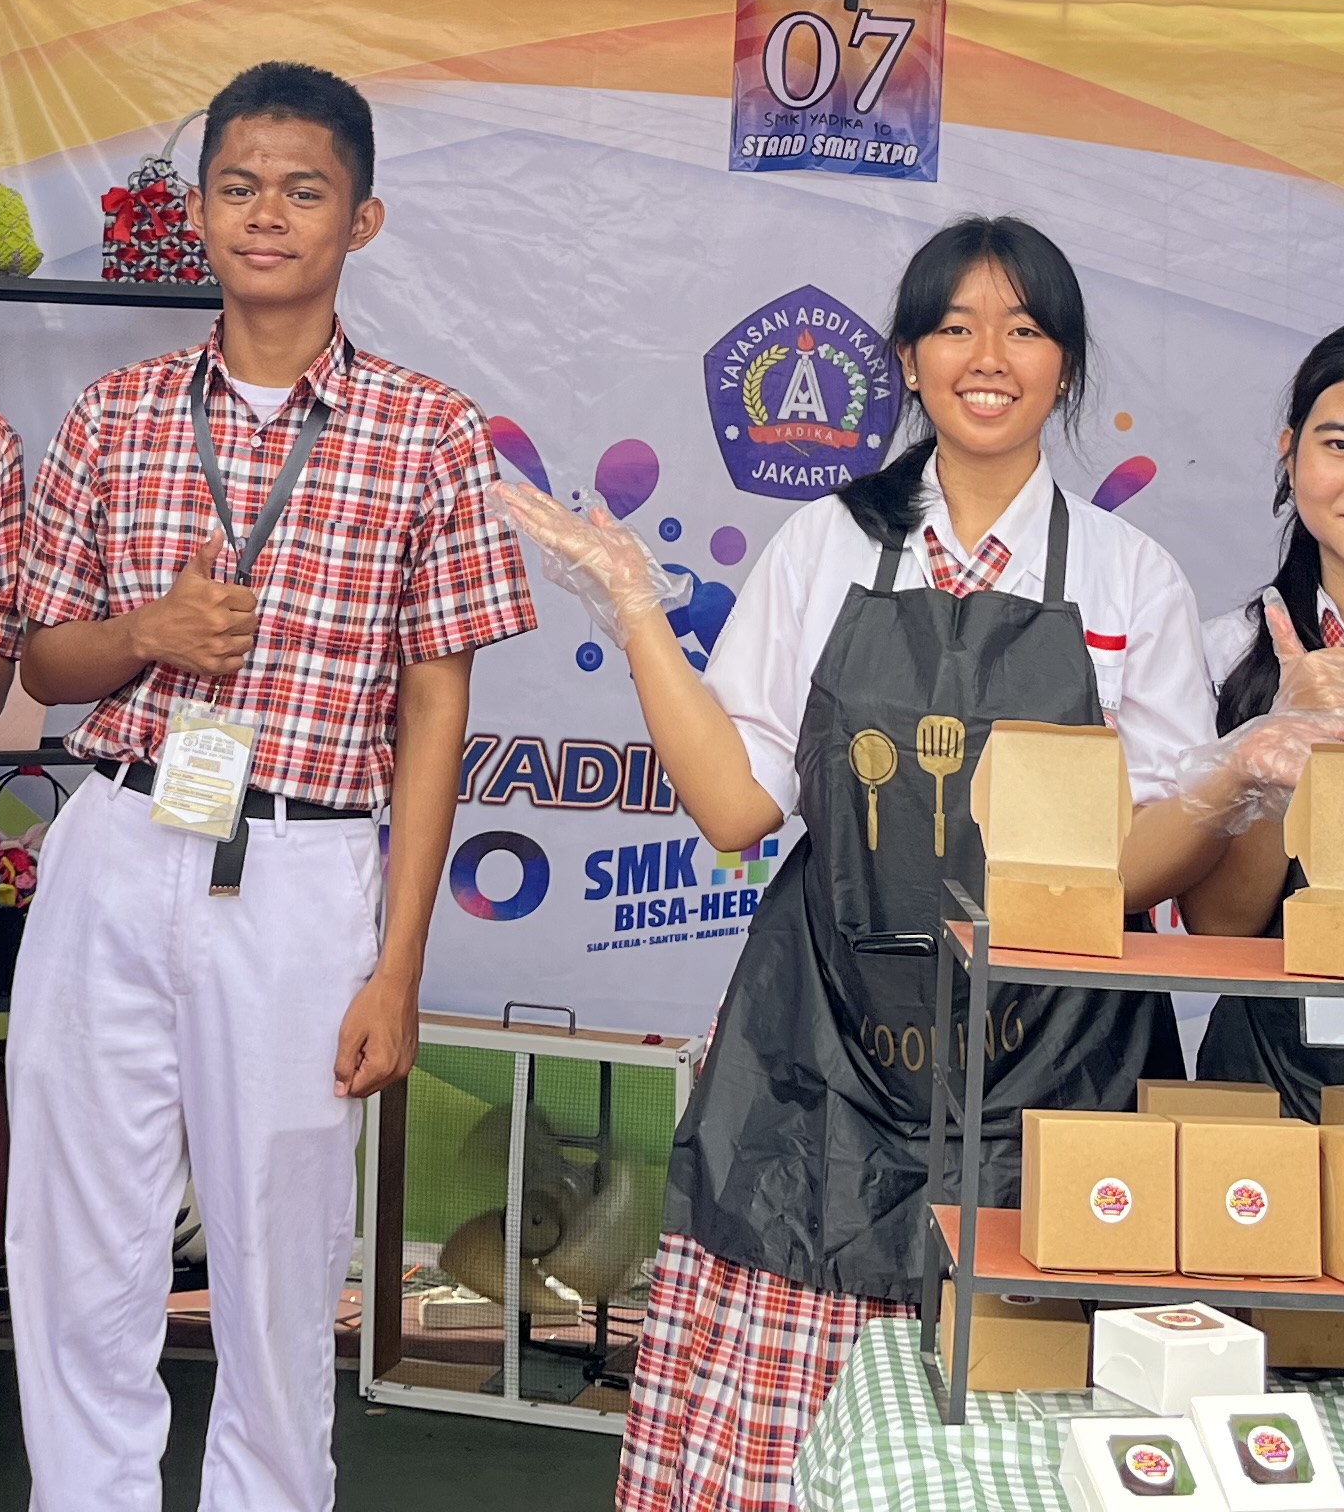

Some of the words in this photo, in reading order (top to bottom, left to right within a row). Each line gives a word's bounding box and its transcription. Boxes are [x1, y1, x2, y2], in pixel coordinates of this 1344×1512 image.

[762, 8, 916, 115] 07
[764, 112, 800, 128] SMK
[809, 113, 863, 130] YADIKA
[874, 122, 892, 136] 10
[741, 134, 807, 158] STAND
[811, 134, 860, 160] SMK
[864, 140, 919, 167] EXPO
[720, 309, 790, 391] YAYASAN
[795, 307, 850, 335] ABDI
[848, 328, 891, 401] KARYA
[774, 427, 833, 442] YADIKA
[752, 460, 853, 487] JAKARTA
[584, 837, 700, 900] SMK
[586, 941, 610, 953] SIAP
[612, 938, 641, 950] KERJA
[649, 933, 688, 945] SANTUN
[696, 926, 739, 939] MANDIRI
